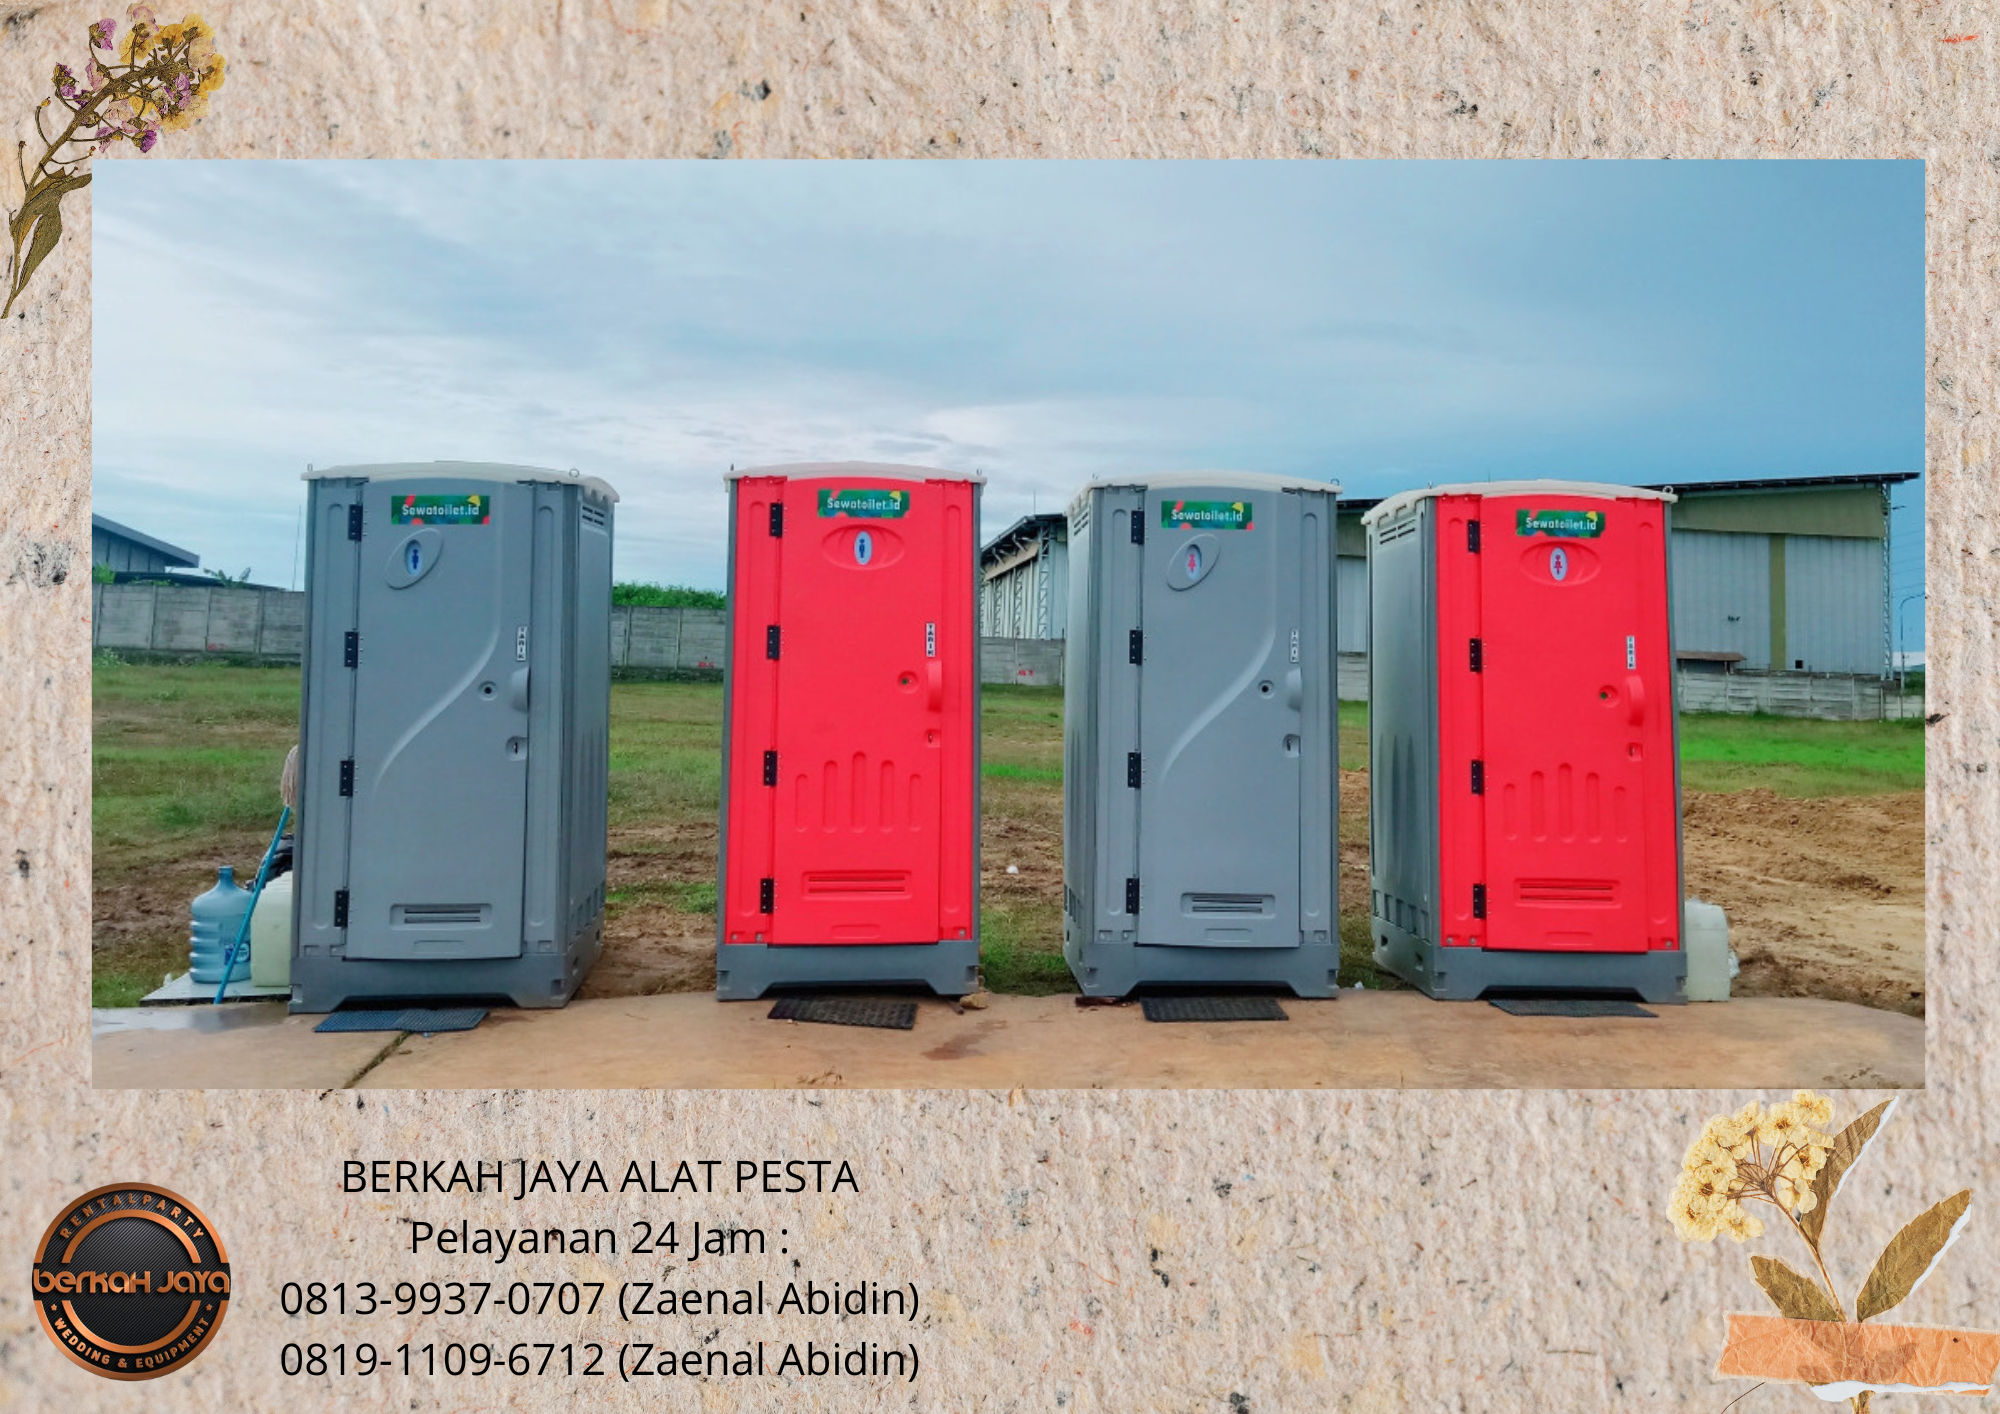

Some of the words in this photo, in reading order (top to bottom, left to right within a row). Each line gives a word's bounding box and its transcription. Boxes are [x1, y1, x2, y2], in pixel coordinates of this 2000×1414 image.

[402, 503, 480, 516] Sewatoilet.id
[826, 497, 902, 510] Sewatoilet.id
[1170, 508, 1244, 522] Sewatoilet.id
[1525, 517, 1598, 530] Sewatoilet.id
